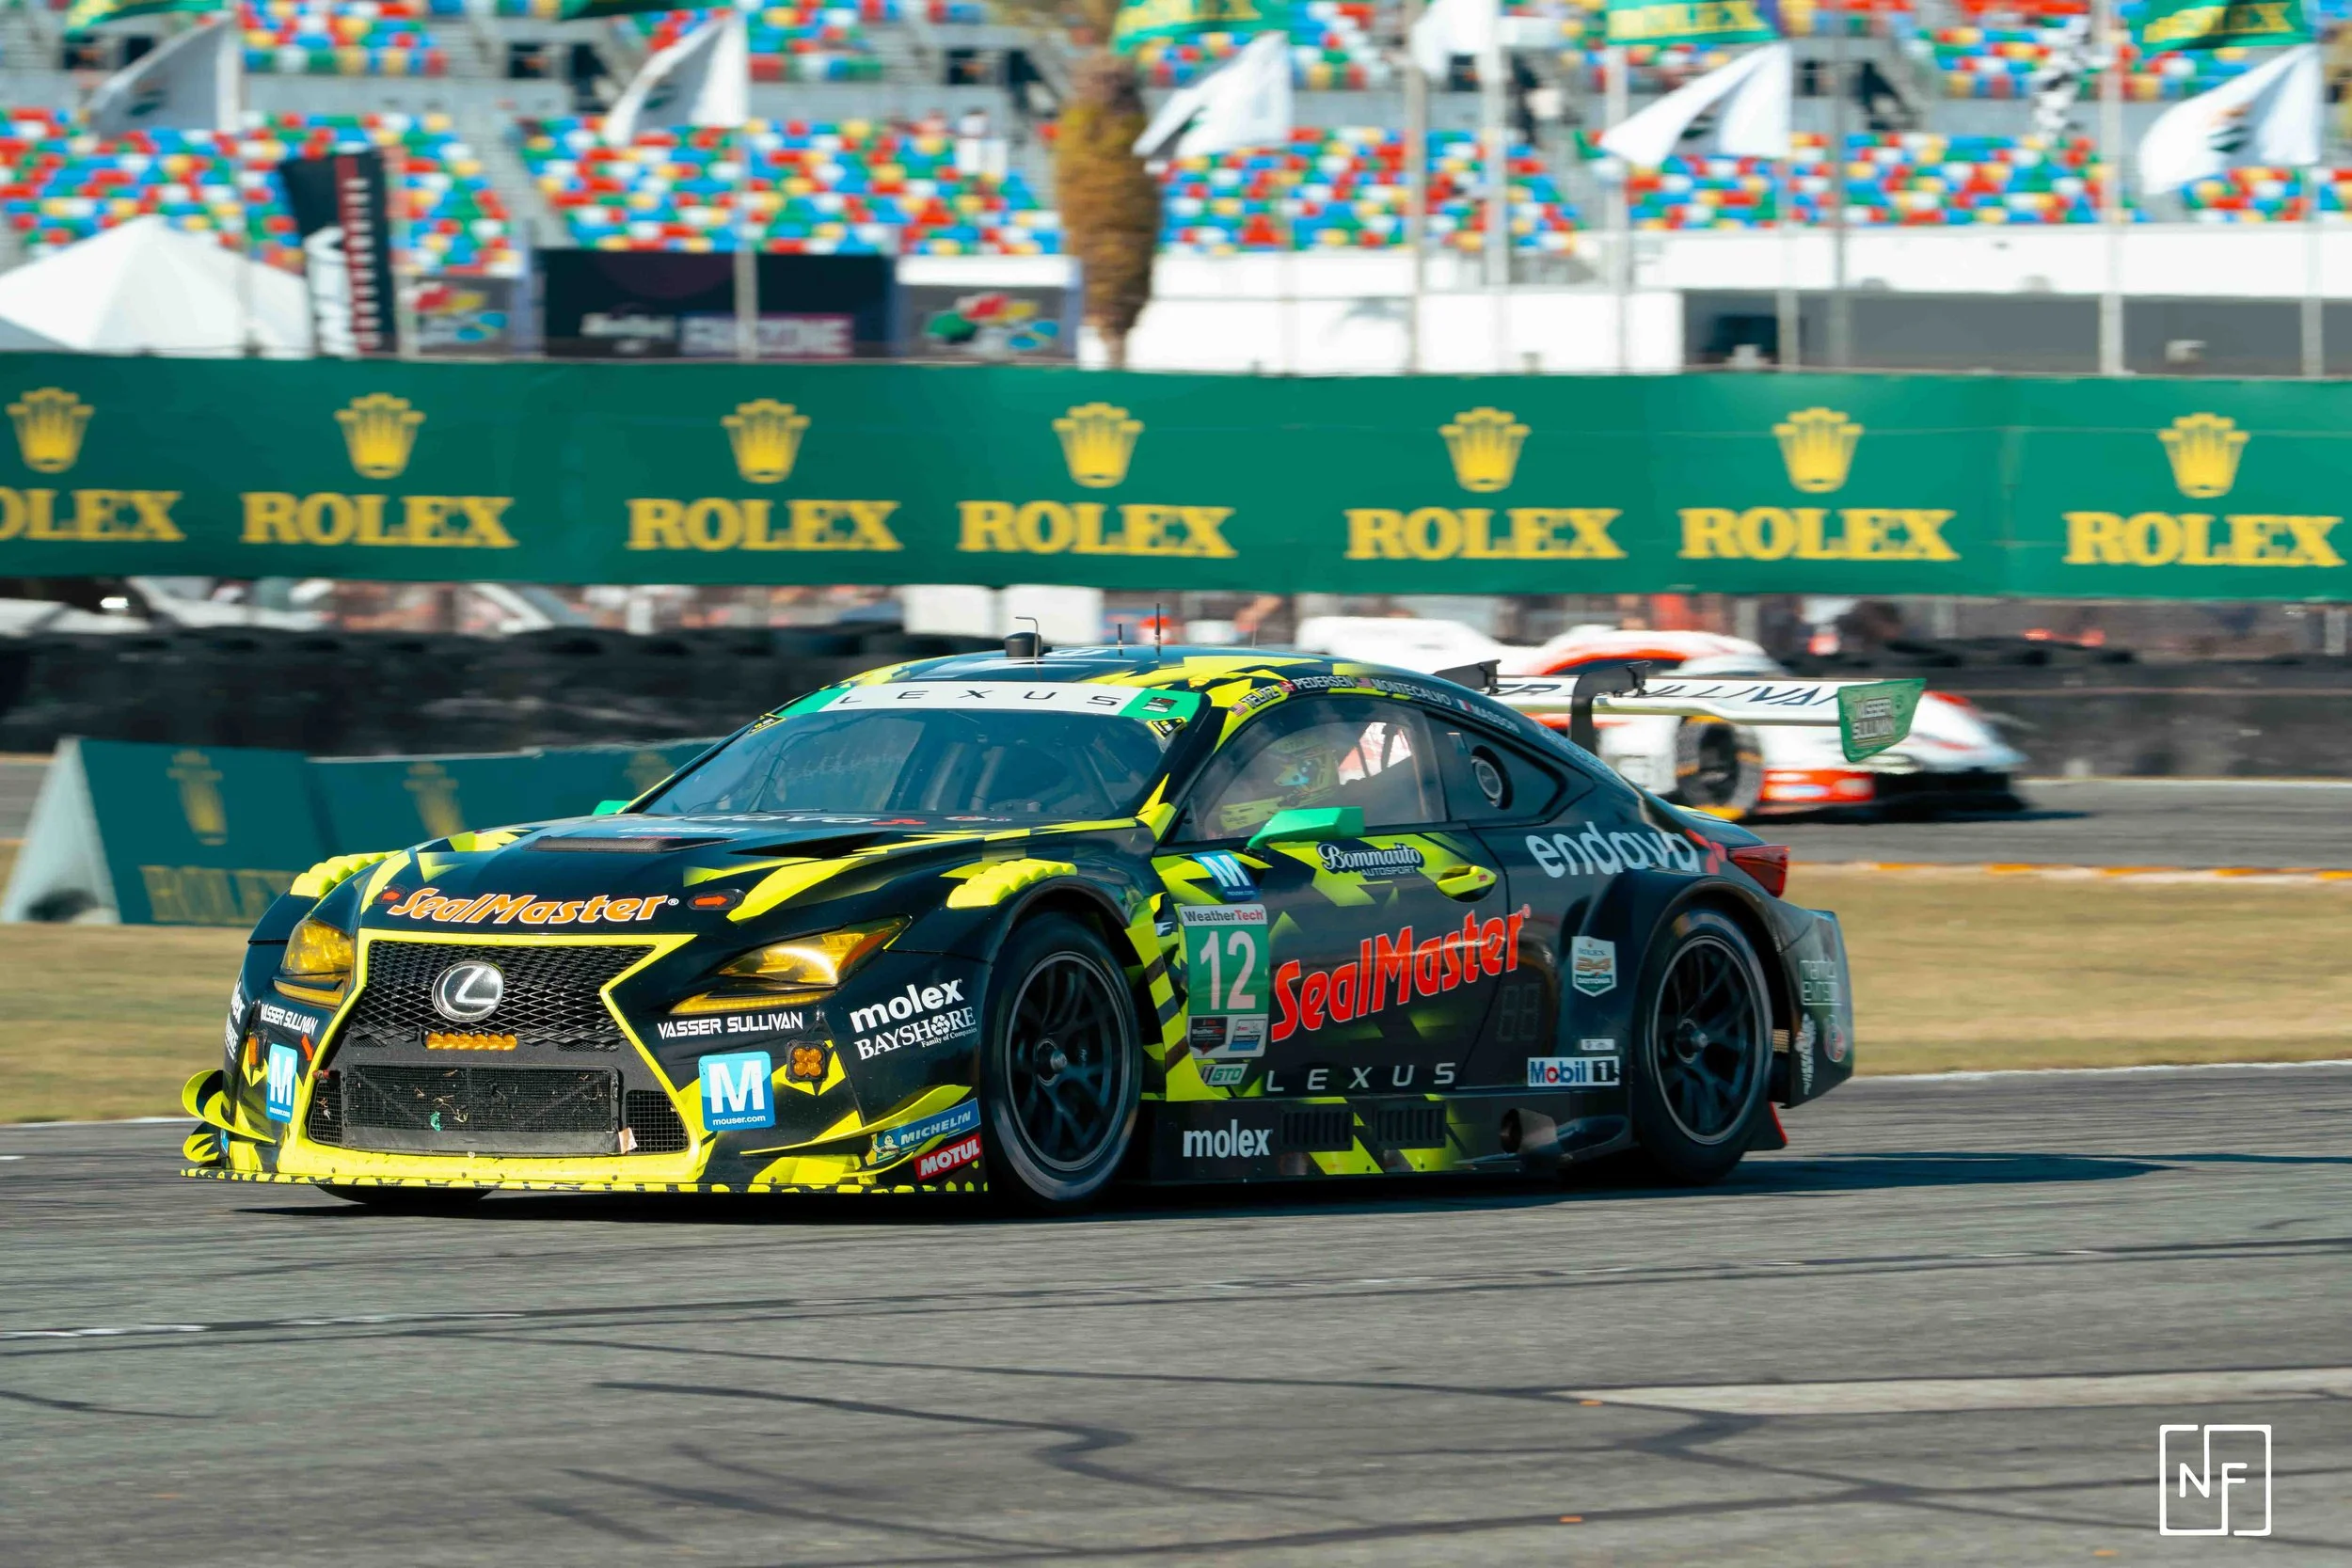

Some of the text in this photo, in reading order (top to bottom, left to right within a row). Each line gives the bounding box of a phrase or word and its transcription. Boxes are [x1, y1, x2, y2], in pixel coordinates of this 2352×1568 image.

[0, 486, 186, 543] OLEX
[239, 491, 520, 547] ROLEX
[625, 497, 904, 551] ROLEX
[957, 499, 1239, 558] ROLEX
[1343, 506, 1629, 561] ROLEX
[1677, 506, 1962, 562] ROLEX
[2061, 511, 2348, 567] ROLEX
[838, 689, 1122, 707] LEXUS
[1293, 675, 1356, 690] PEDERSEN
[1371, 678, 1453, 705] MONTECALVO
[1318, 843, 1422, 870] Bommarito
[1526, 821, 1701, 879] endava
[1199, 854, 1251, 887] M
[1362, 865, 1415, 877] AUTOSPORT
[387, 887, 669, 926] SealMaster
[1184, 909, 1264, 923] WeatherTech
[1200, 930, 1256, 1010] 12
[1271, 910, 1524, 1042] SealMaster
[261, 1003, 319, 1037] VASSER SULLIVAN
[850, 979, 964, 1033] molex
[658, 1011, 803, 1040] VASSER SULLIVAN
[921, 1036, 943, 1048] Family
[949, 1027, 977, 1039] Companies
[269, 1052, 294, 1107] M
[707, 1059, 766, 1114] M
[1211, 1068, 1243, 1082] GTD
[1266, 1062, 1456, 1092] LEXUS
[1530, 1060, 1608, 1084] Mobil 1
[712, 1115, 767, 1126] mouser.com
[900, 1111, 972, 1146] MICHELIN
[1183, 1119, 1270, 1158] molex
[920, 1139, 980, 1176] MOTUL
